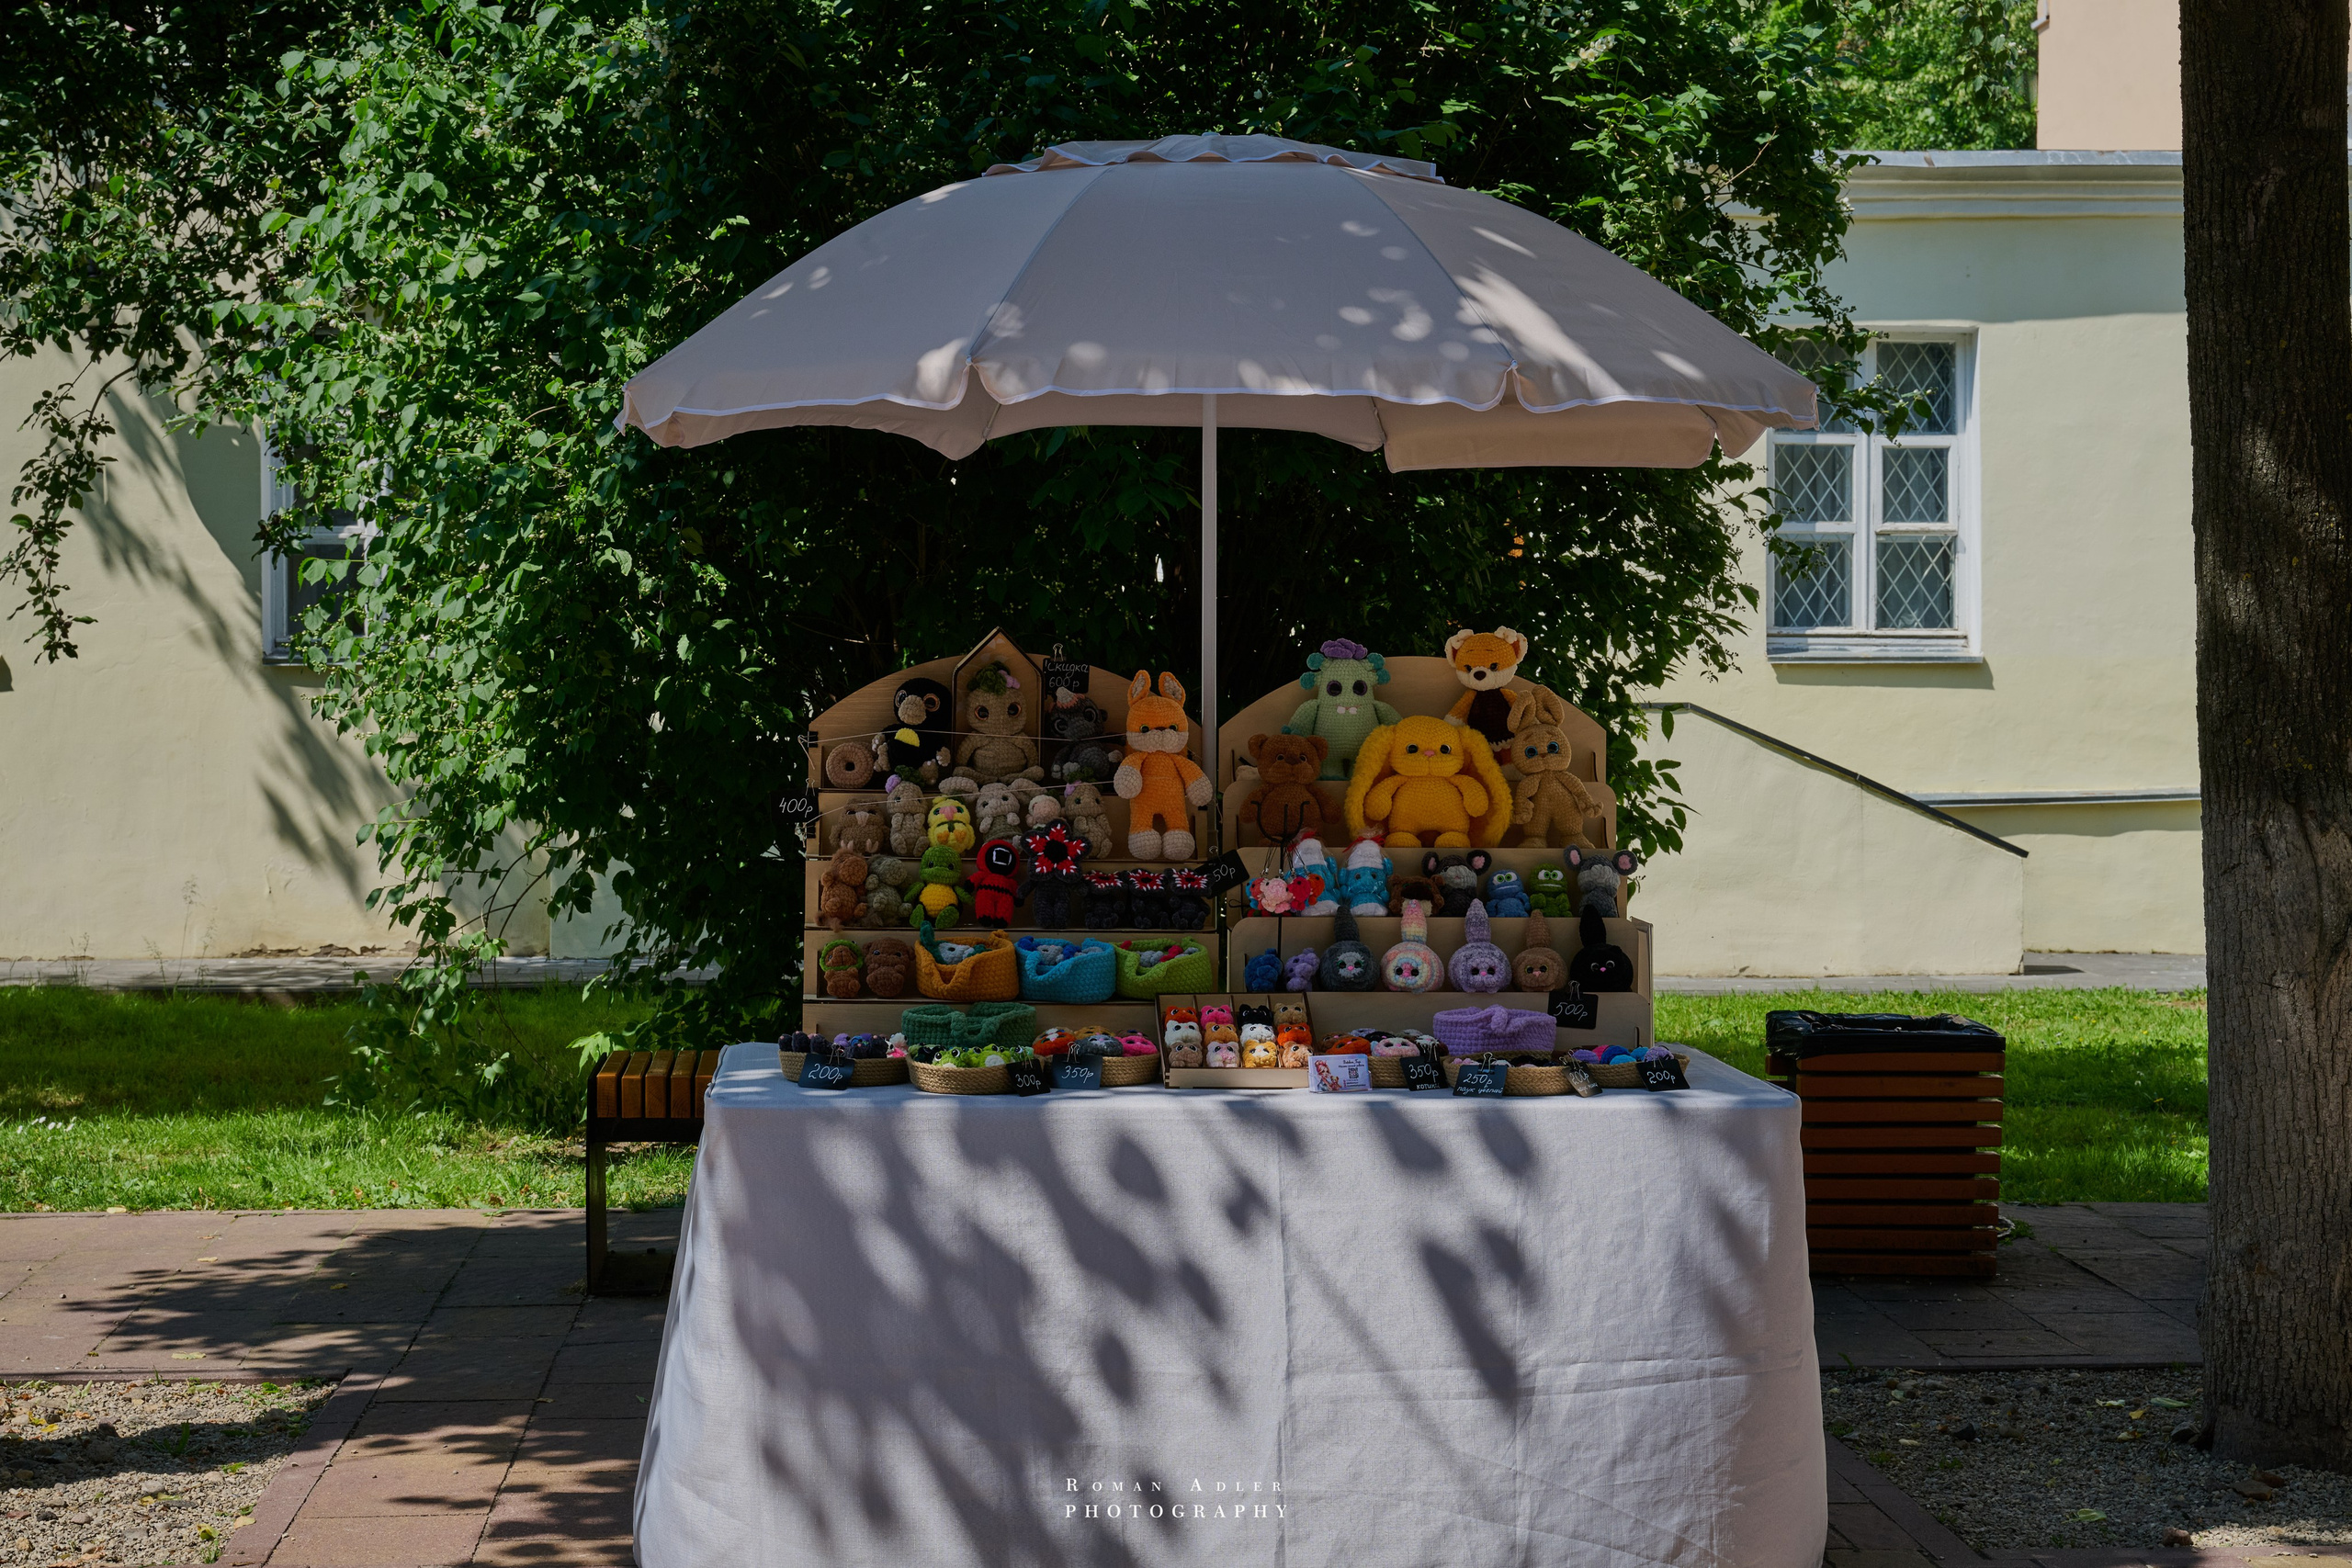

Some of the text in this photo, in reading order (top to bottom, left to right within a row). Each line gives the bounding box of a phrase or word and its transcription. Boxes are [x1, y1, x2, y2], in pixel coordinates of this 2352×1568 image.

[778, 797, 813, 818] 400р
[1553, 1001, 1588, 1021] 500р
[808, 1063, 843, 1084] 200р
[1015, 1074, 1041, 1089] 300р
[1061, 1065, 1094, 1084] 350р
[1408, 1064, 1439, 1083] 350р
[1463, 1073, 1493, 1089] 250р
[1568, 1068, 1590, 1086] 200р
[1646, 1070, 1676, 1085] 200р
